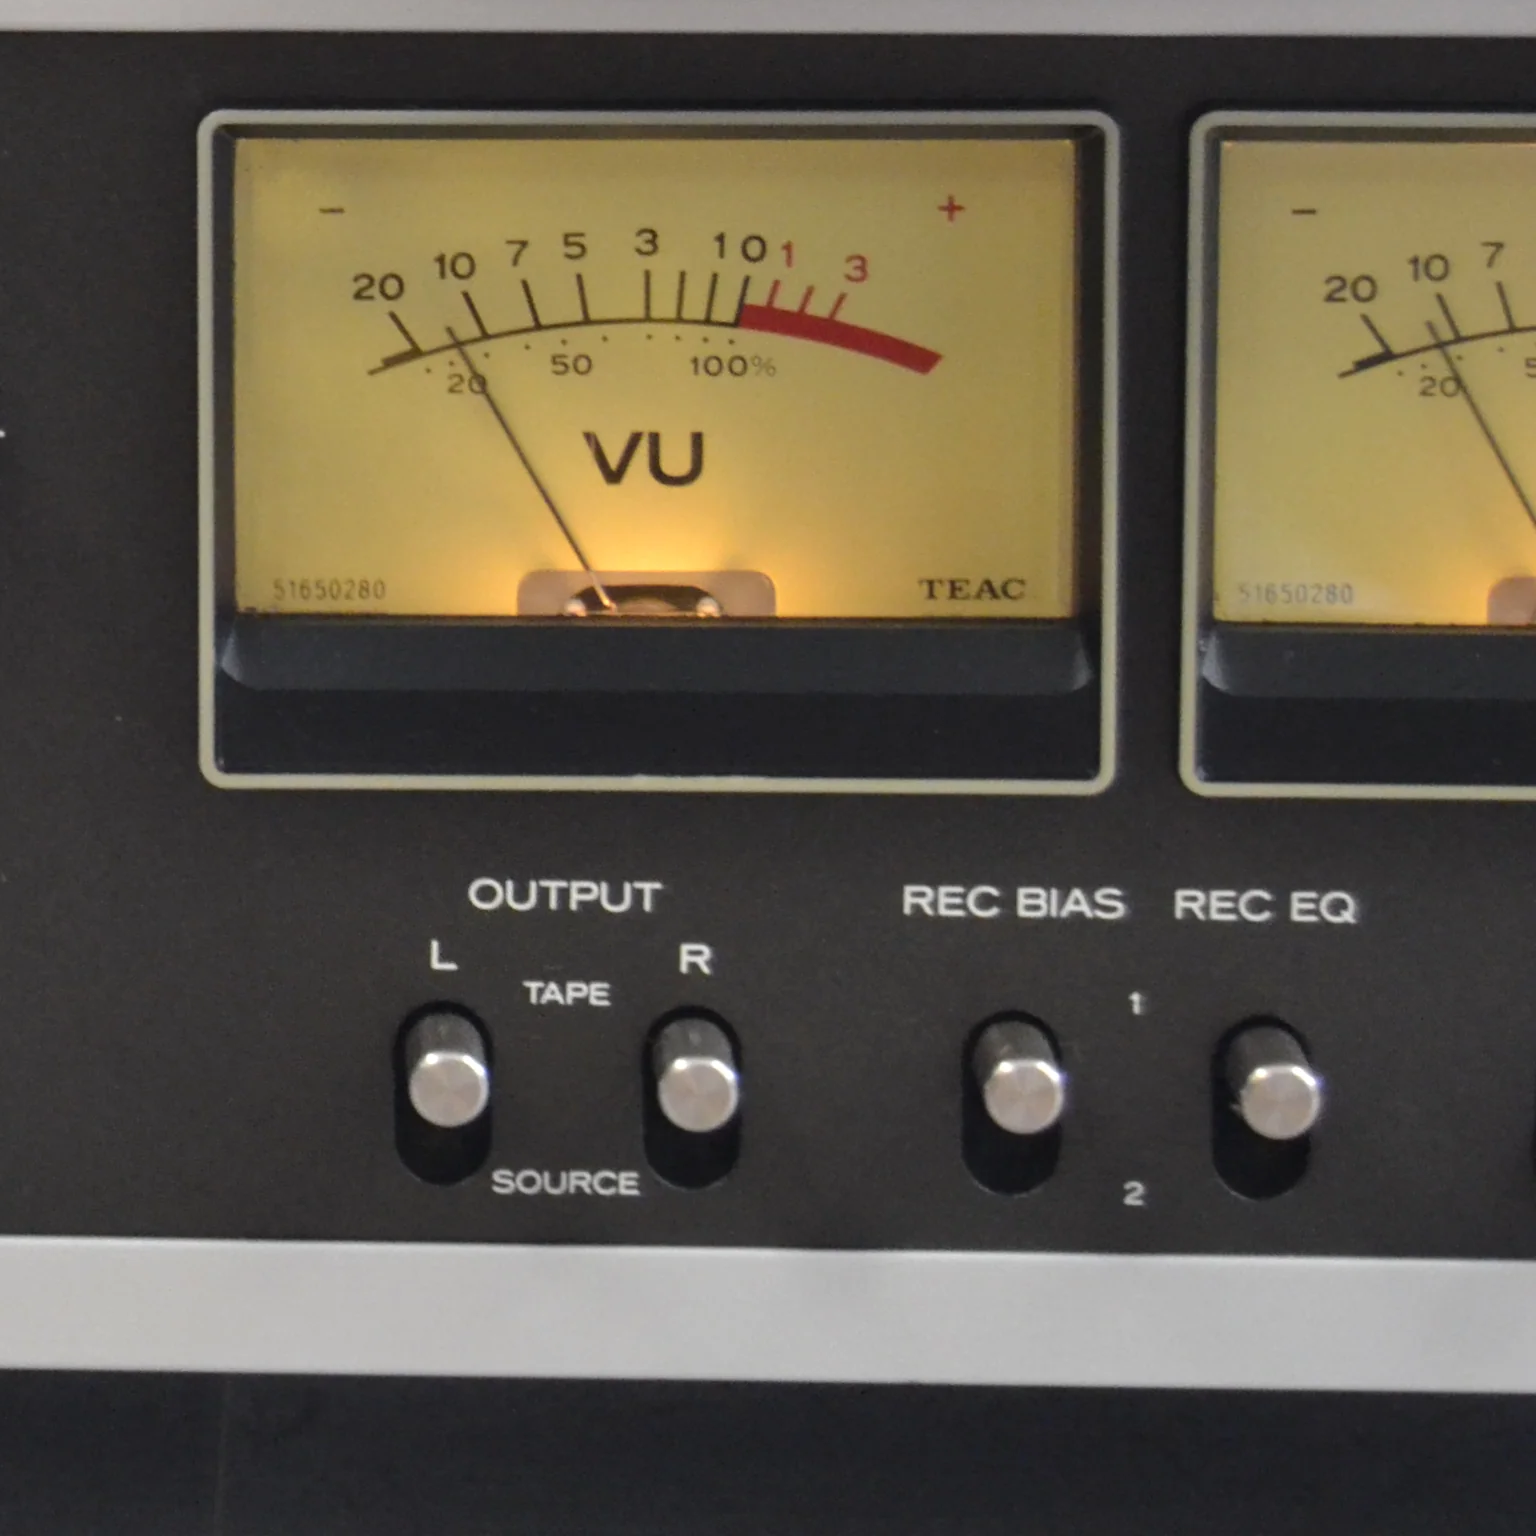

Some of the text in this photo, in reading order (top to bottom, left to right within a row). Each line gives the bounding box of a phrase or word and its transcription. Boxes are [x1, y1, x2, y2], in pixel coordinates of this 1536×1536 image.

[352, 272, 405, 302] 20
[434, 251, 477, 281] 10
[505, 239, 529, 268] 7
[562, 232, 588, 261] 5
[635, 227, 659, 257] 3
[781, 240, 794, 268] 1
[844, 254, 869, 284] 3
[1323, 241, 1505, 304] 20 10 7
[447, 373, 488, 395] 20
[550, 353, 593, 377] 50
[582, 431, 704, 487] VU
[272, 577, 386, 601] 51650280
[919, 578, 1026, 602] TEAC
[467, 877, 663, 913] OUTPUT
[903, 884, 1127, 920] REC BIAS
[1174, 889, 1358, 924] REC EQ
[430, 939, 712, 975] L R
[522, 980, 611, 1007] TAPE
[491, 1168, 641, 1196] SOURCE
[1123, 1180, 1146, 1207] 2
